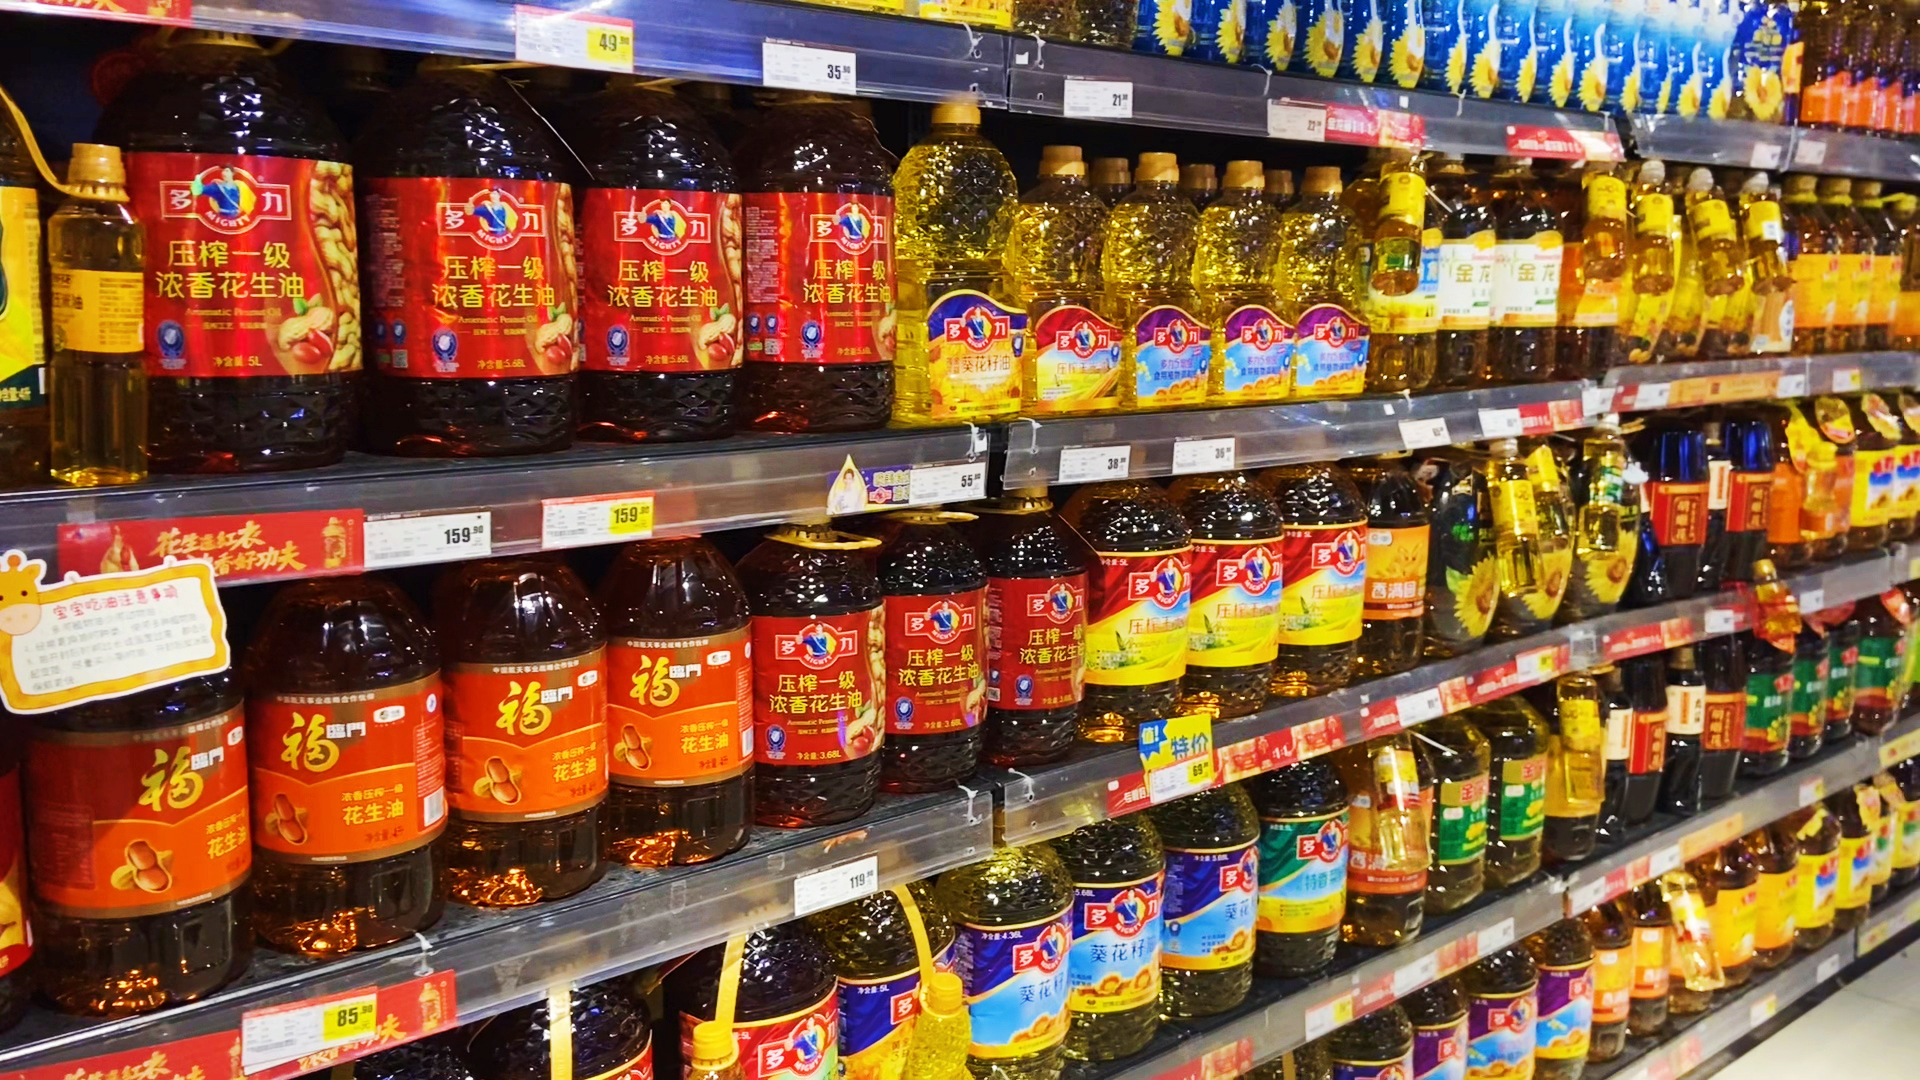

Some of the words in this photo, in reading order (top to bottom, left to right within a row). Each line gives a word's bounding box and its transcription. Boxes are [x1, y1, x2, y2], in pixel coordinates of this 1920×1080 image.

[170, 188, 192, 210] 多
[262, 192, 282, 212] 力
[204, 210, 252, 229] MIGHTY
[444, 209, 464, 229] 多
[522, 212, 538, 230] 力
[620, 217, 638, 236] 多
[690, 220, 706, 238] 力
[817, 220, 832, 237] 多
[873, 222, 884, 238] 力
[476, 228, 514, 244] MIGHTY
[648, 236, 682, 249] MIGHTY
[168, 240, 290, 269] 压榨一级
[444, 256, 544, 280] 压榨一级
[618, 259, 709, 284] 压榨一级
[812, 258, 886, 281] 压榨一级
[155, 271, 304, 298] 浓香花生油
[803, 282, 892, 304] 浓香花生油
[432, 284, 554, 309] 浓香花生油
[607, 284, 718, 308] 浓香花生油
[949, 324, 961, 338] 多
[994, 322, 1006, 336] 力
[1060, 335, 1072, 348] 多
[1098, 334, 1108, 347] 力
[614, 506, 650, 524] 159.90
[444, 525, 484, 545] 159.90
[187, 540, 307, 577] 香好功夫
[1318, 548, 1331, 564] 多
[1222, 565, 1238, 582] 多
[1134, 578, 1150, 596] 多
[52, 584, 179, 620] 宝宝吃油注意事项
[1032, 598, 1044, 613] 多
[910, 616, 924, 632] 多
[962, 612, 974, 627] 力
[781, 639, 796, 656] 多
[840, 635, 854, 652] 力
[906, 644, 975, 667] 压榨一级
[804, 652, 833, 666] MIGHTY
[777, 670, 856, 694] 压榨一级
[898, 663, 979, 688] 浓香花生油
[769, 690, 862, 715] 浓香花生油
[681, 733, 730, 754] 花生油
[1171, 732, 1208, 760] 特价
[553, 756, 597, 782] 花生油
[343, 800, 404, 826] 花生油
[1302, 840, 1316, 854] 多
[1224, 870, 1238, 886] 多
[1090, 909, 1107, 926] 多
[1018, 950, 1034, 967] 多
[857, 984, 890, 995] 净含量:5L
[337, 1005, 373, 1028] 85.90
[897, 997, 914, 1016] 多
[766, 1047, 784, 1068] 多
